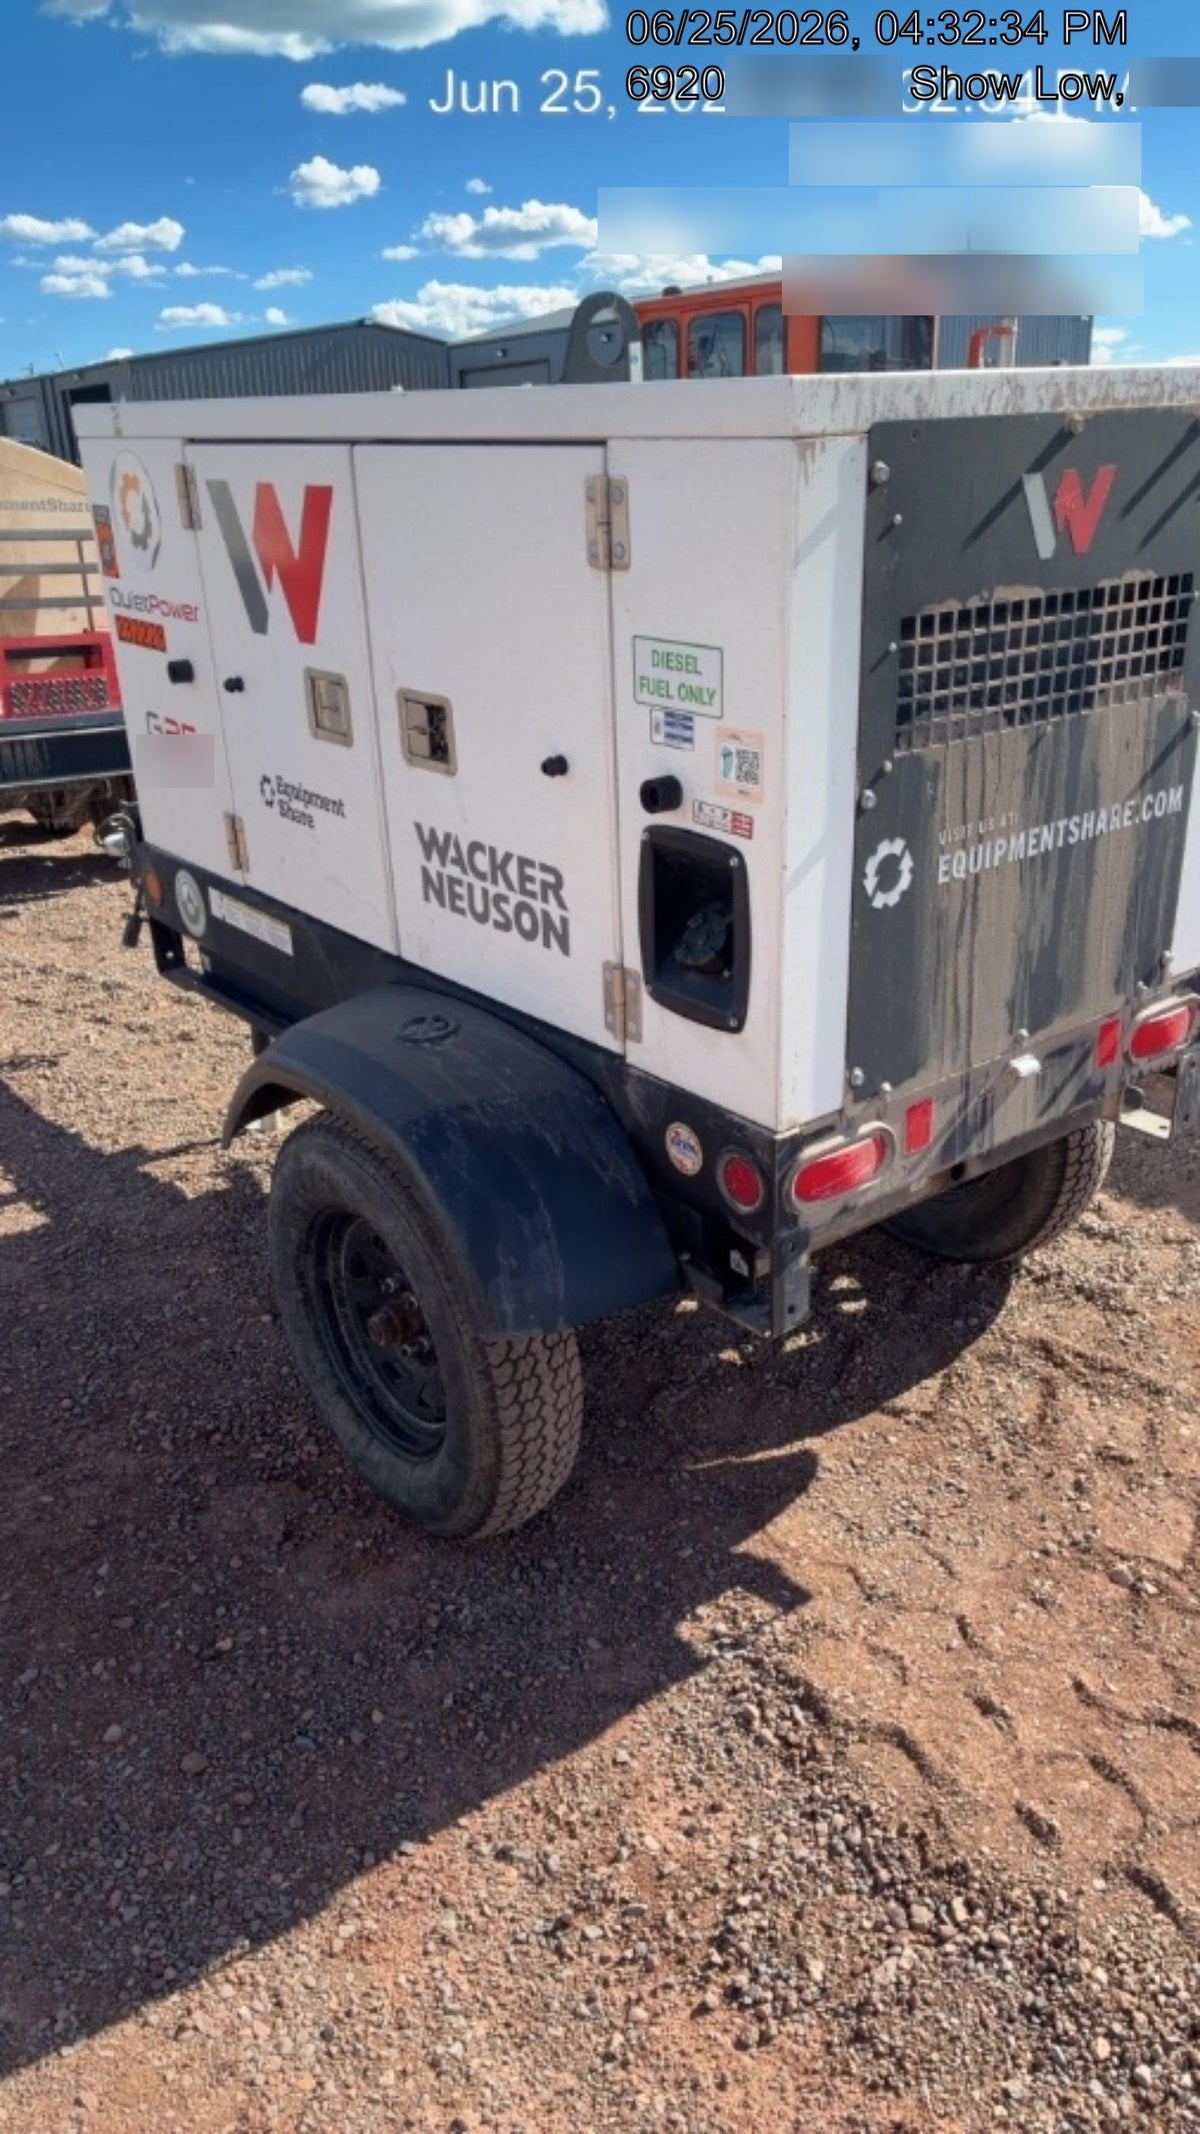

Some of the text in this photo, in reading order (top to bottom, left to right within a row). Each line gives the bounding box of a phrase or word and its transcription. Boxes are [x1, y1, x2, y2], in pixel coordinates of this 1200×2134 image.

[651, 649, 702, 676] DIESEL
[639, 675, 717, 707] FUEL ONLY
[275, 775, 346, 818] Equipment
[278, 801, 315, 829] Share
[938, 784, 1184, 885] EQUIPMENTSHARE.COM
[413, 821, 568, 912] WACKER
[421, 865, 570, 957] NEUSON
